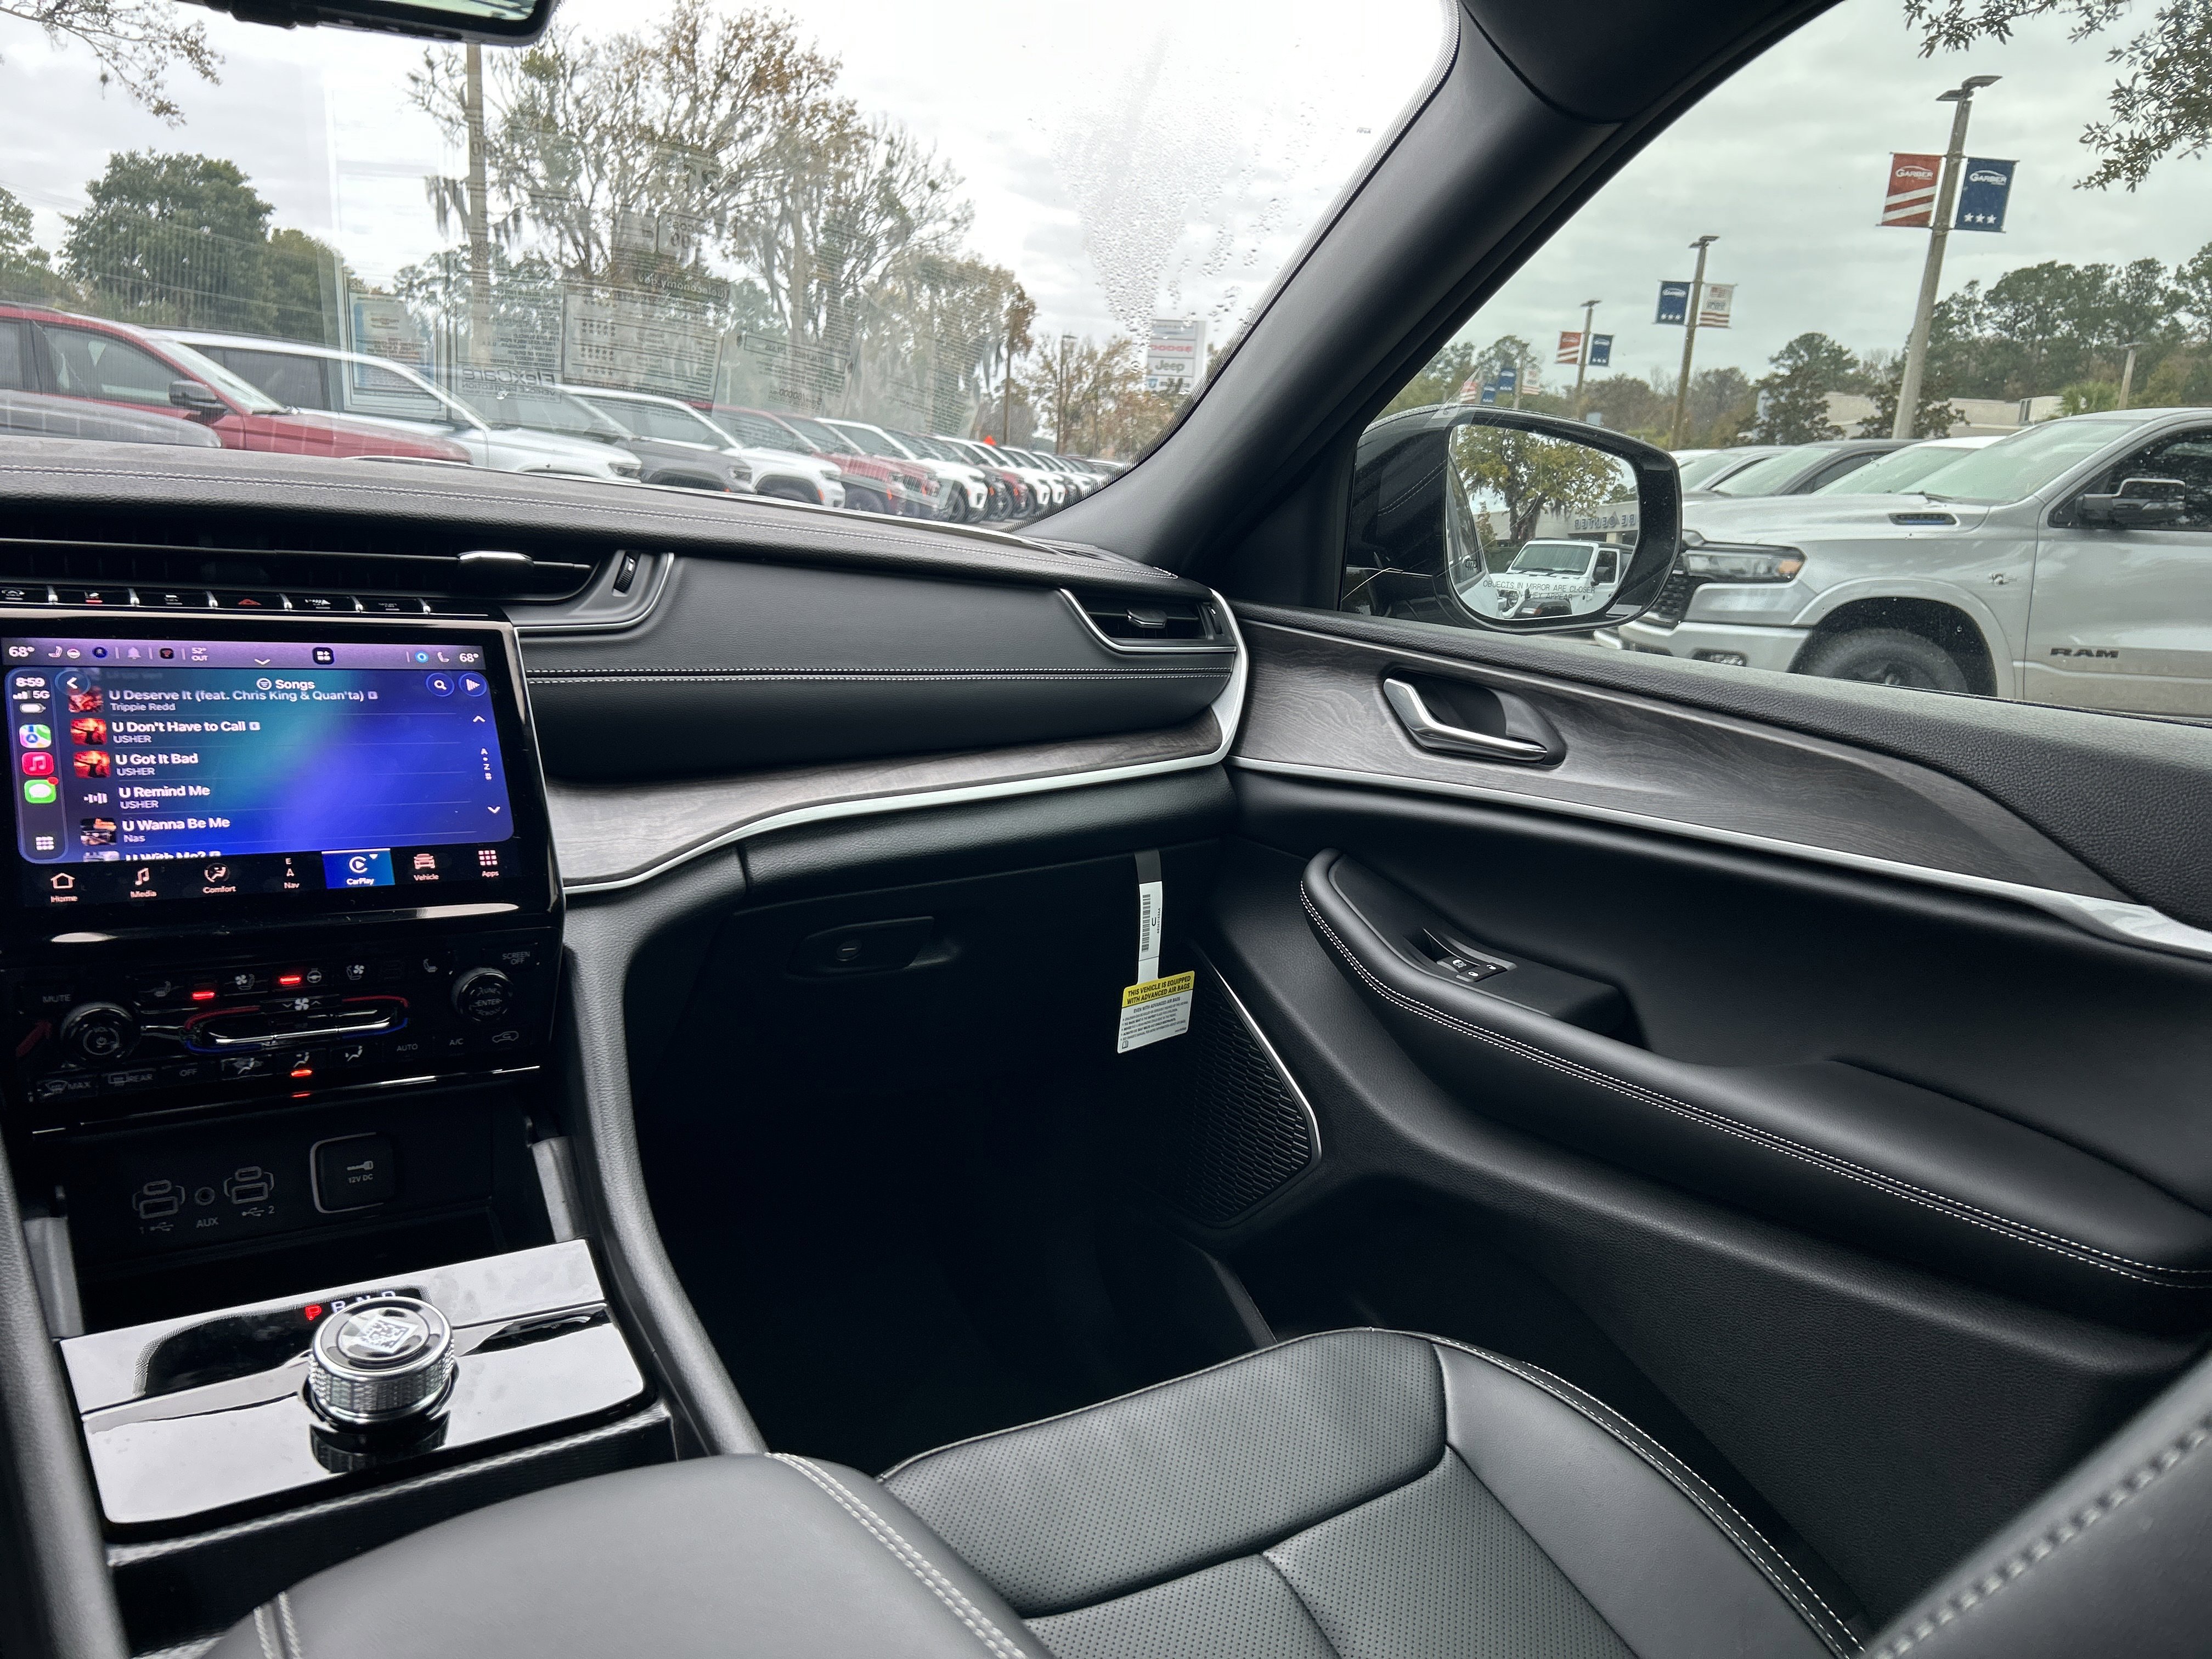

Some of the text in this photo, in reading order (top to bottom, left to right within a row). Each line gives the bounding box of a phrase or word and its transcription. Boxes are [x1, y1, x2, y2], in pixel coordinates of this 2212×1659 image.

[1895, 167, 1933, 178] GARBER
[1970, 172, 2007, 183] GARBER
[1150, 345, 1193, 353] DODGE
[1155, 360, 1185, 373] Jeep
[1545, 592, 1572, 601] APPEAR
[8, 646, 35, 658] 68°
[2050, 648, 2119, 658] RAM
[459, 652, 479, 663] 68°
[15, 677, 46, 688] 8:59
[275, 679, 315, 691] Songs
[32, 691, 50, 700] 5G
[109, 690, 364, 703] U Deserve It (feat. Chris King & Quan'ta)
[111, 702, 176, 712] Trippie Redd
[112, 721, 246, 732] U Don't Have to Call
[113, 735, 152, 743] USHER
[115, 753, 199, 765] U Got It Bad
[116, 767, 155, 776] USHER
[119, 786, 211, 798] U Remind Me
[120, 800, 159, 809] USHER
[122, 817, 230, 832] U Wanna Be Me
[123, 834, 145, 843] Nas
[482, 870, 499, 878] Apps
[346, 878, 375, 887] CarPlay
[131, 890, 157, 898] Media
[202, 885, 236, 894] Comfort
[502, 951, 530, 960] SCREEN
[1128, 989, 1139, 997] THIS
[1141, 984, 1161, 994] VEHICLE
[1167, 975, 1191, 987] EQUIPPED
[43, 994, 71, 1003] MUTE
[1127, 996, 1140, 1005] WITH
[1141, 989, 1167, 1001] ADVANCED
[1177, 983, 1190, 991] BAGS
[449, 1038, 464, 1046] A/C
[397, 1043, 418, 1052] AUTO
[348, 1175, 361, 1184] 12V
[269, 1206, 275, 1214] 2
[196, 1217, 219, 1228] AUX
[305, 1305, 322, 1321] P
[330, 1300, 346, 1313] R
